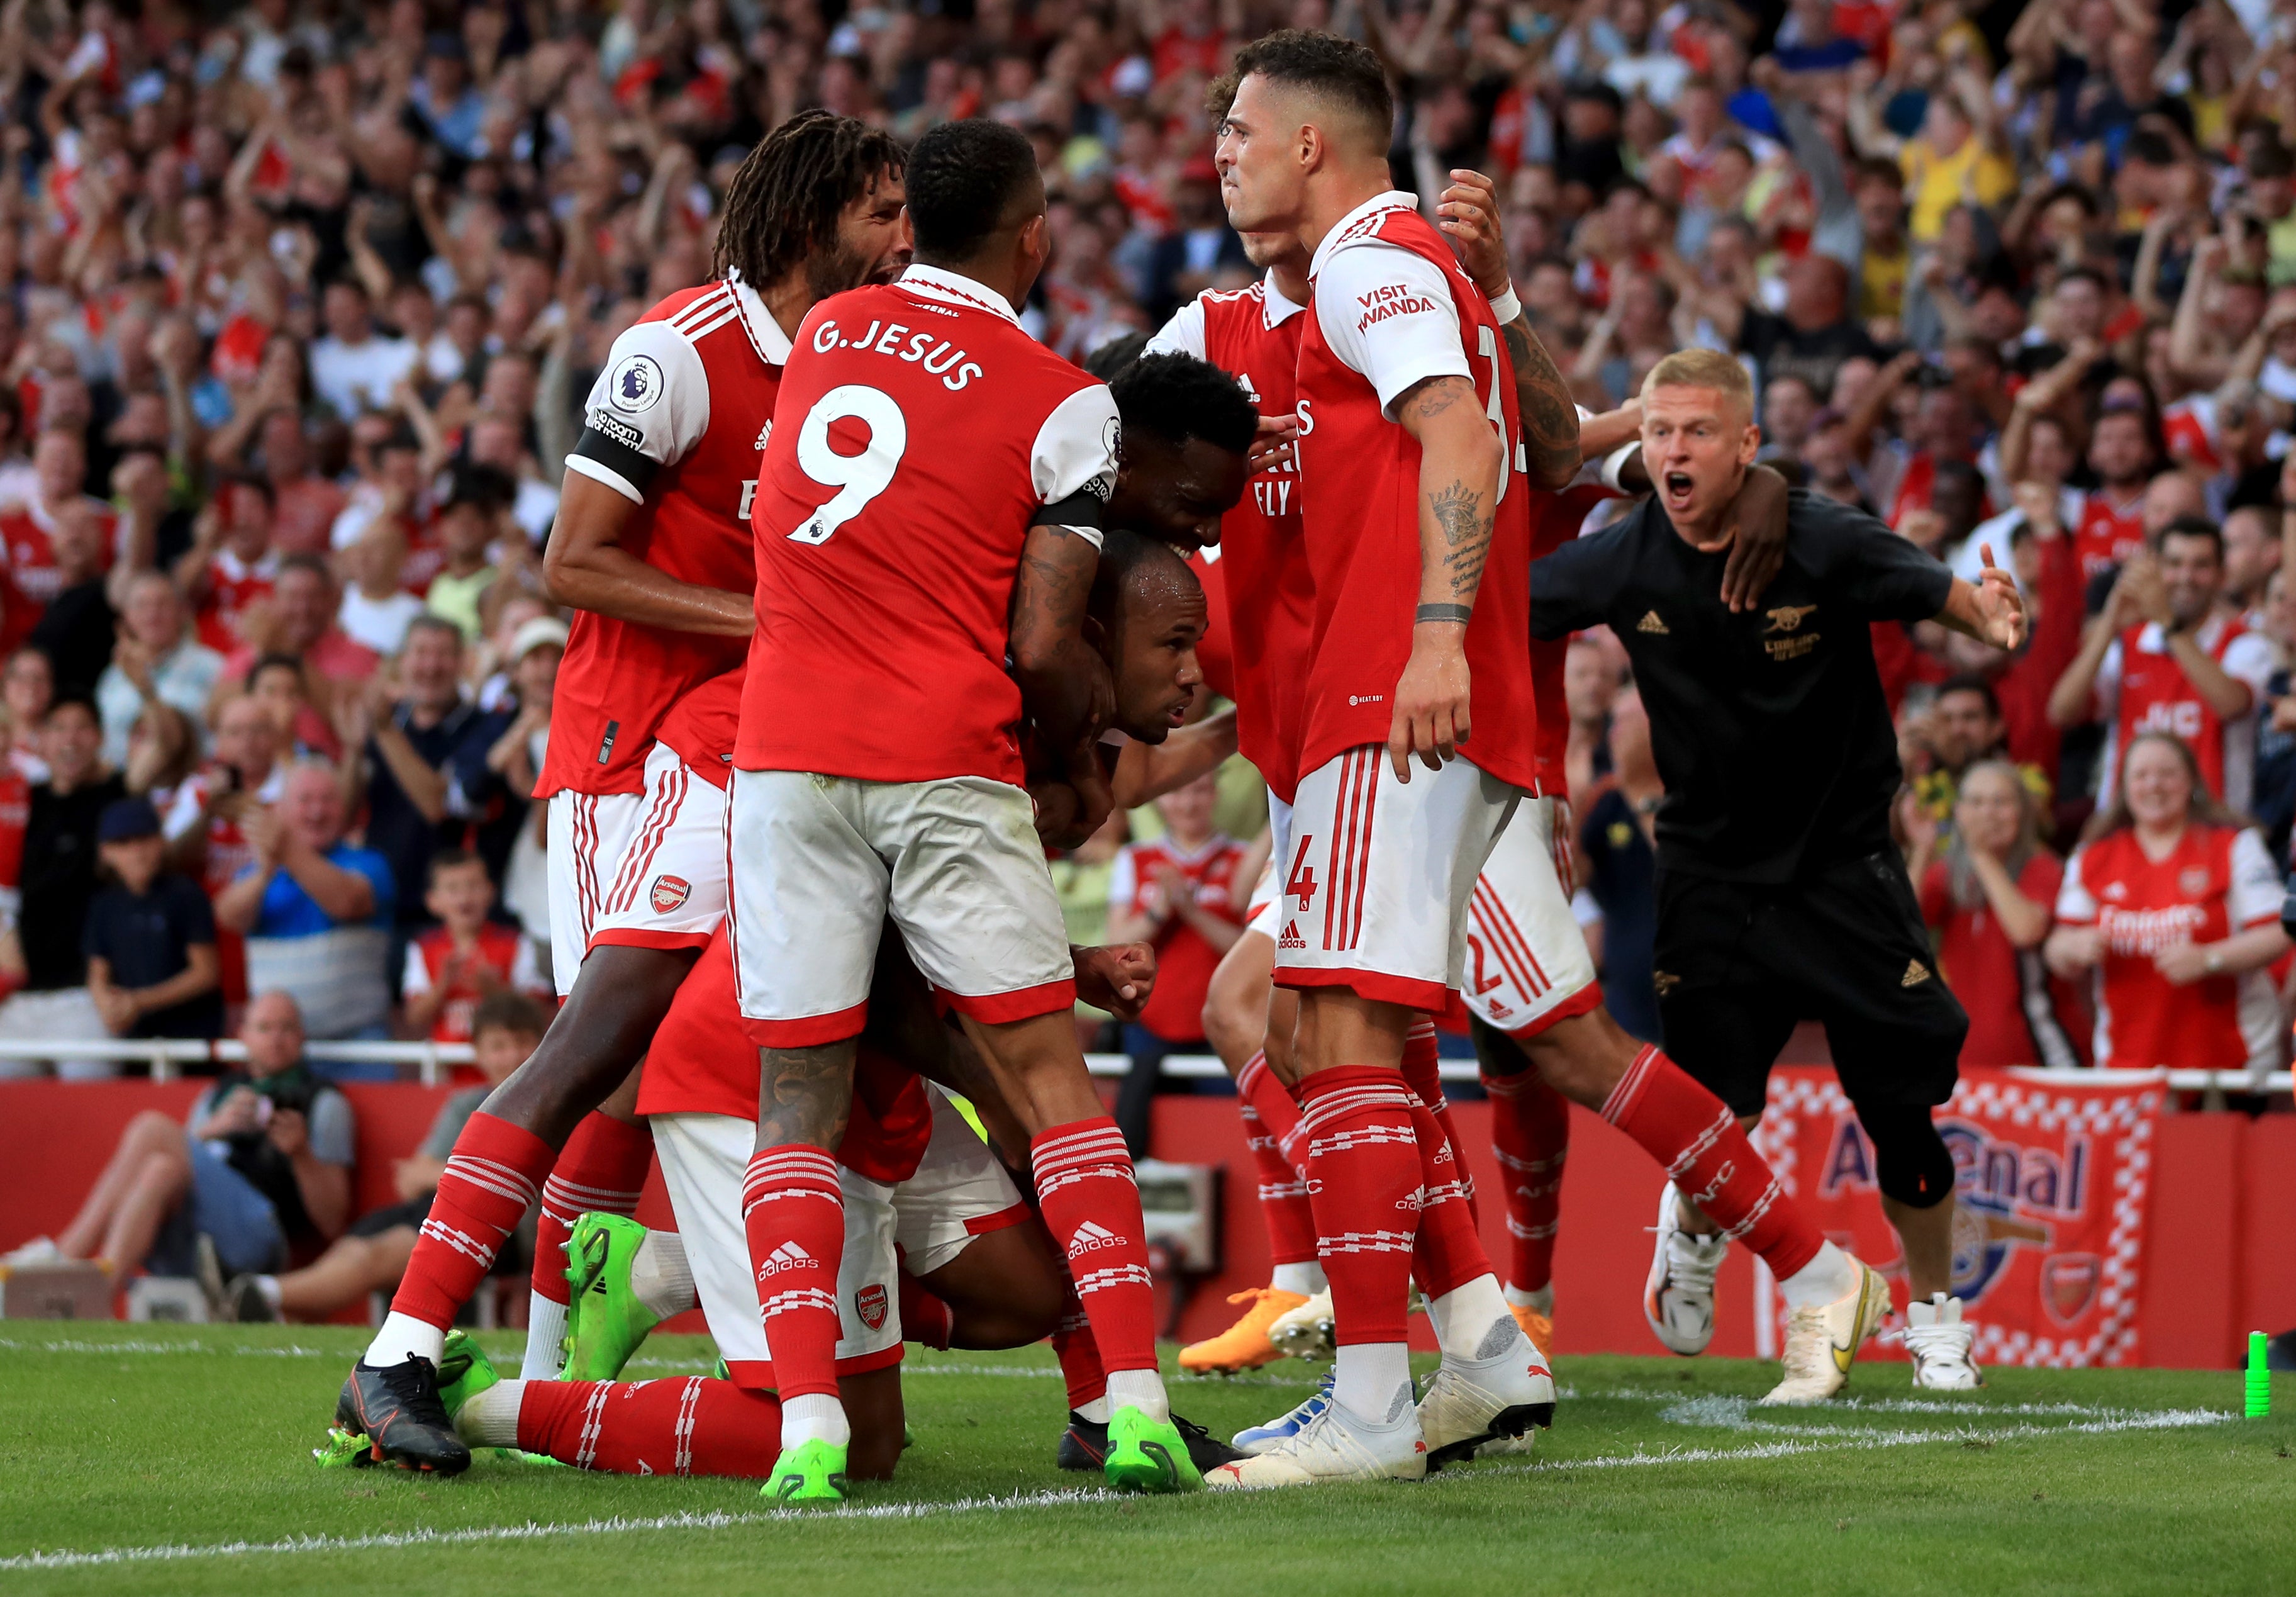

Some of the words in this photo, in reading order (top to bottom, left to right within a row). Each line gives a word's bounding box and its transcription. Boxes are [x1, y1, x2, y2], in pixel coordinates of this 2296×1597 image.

[1357, 284, 1407, 308] VISIT
[813, 320, 983, 391] G.JESUS
[640, 389, 655, 406] League
[594, 406, 608, 424] No
[607, 418, 638, 441] room
[786, 384, 907, 546] 9
[1254, 480, 1291, 517] FLY
[659, 879, 686, 894] Arsenal
[1285, 834, 1318, 912] 4
[1463, 933, 1503, 995] 2
[1823, 1119, 2090, 1217] Aenal
[1067, 1236, 1128, 1260] adidas
[757, 1257, 820, 1282] adidas
[859, 1289, 884, 1304] Arsenal
